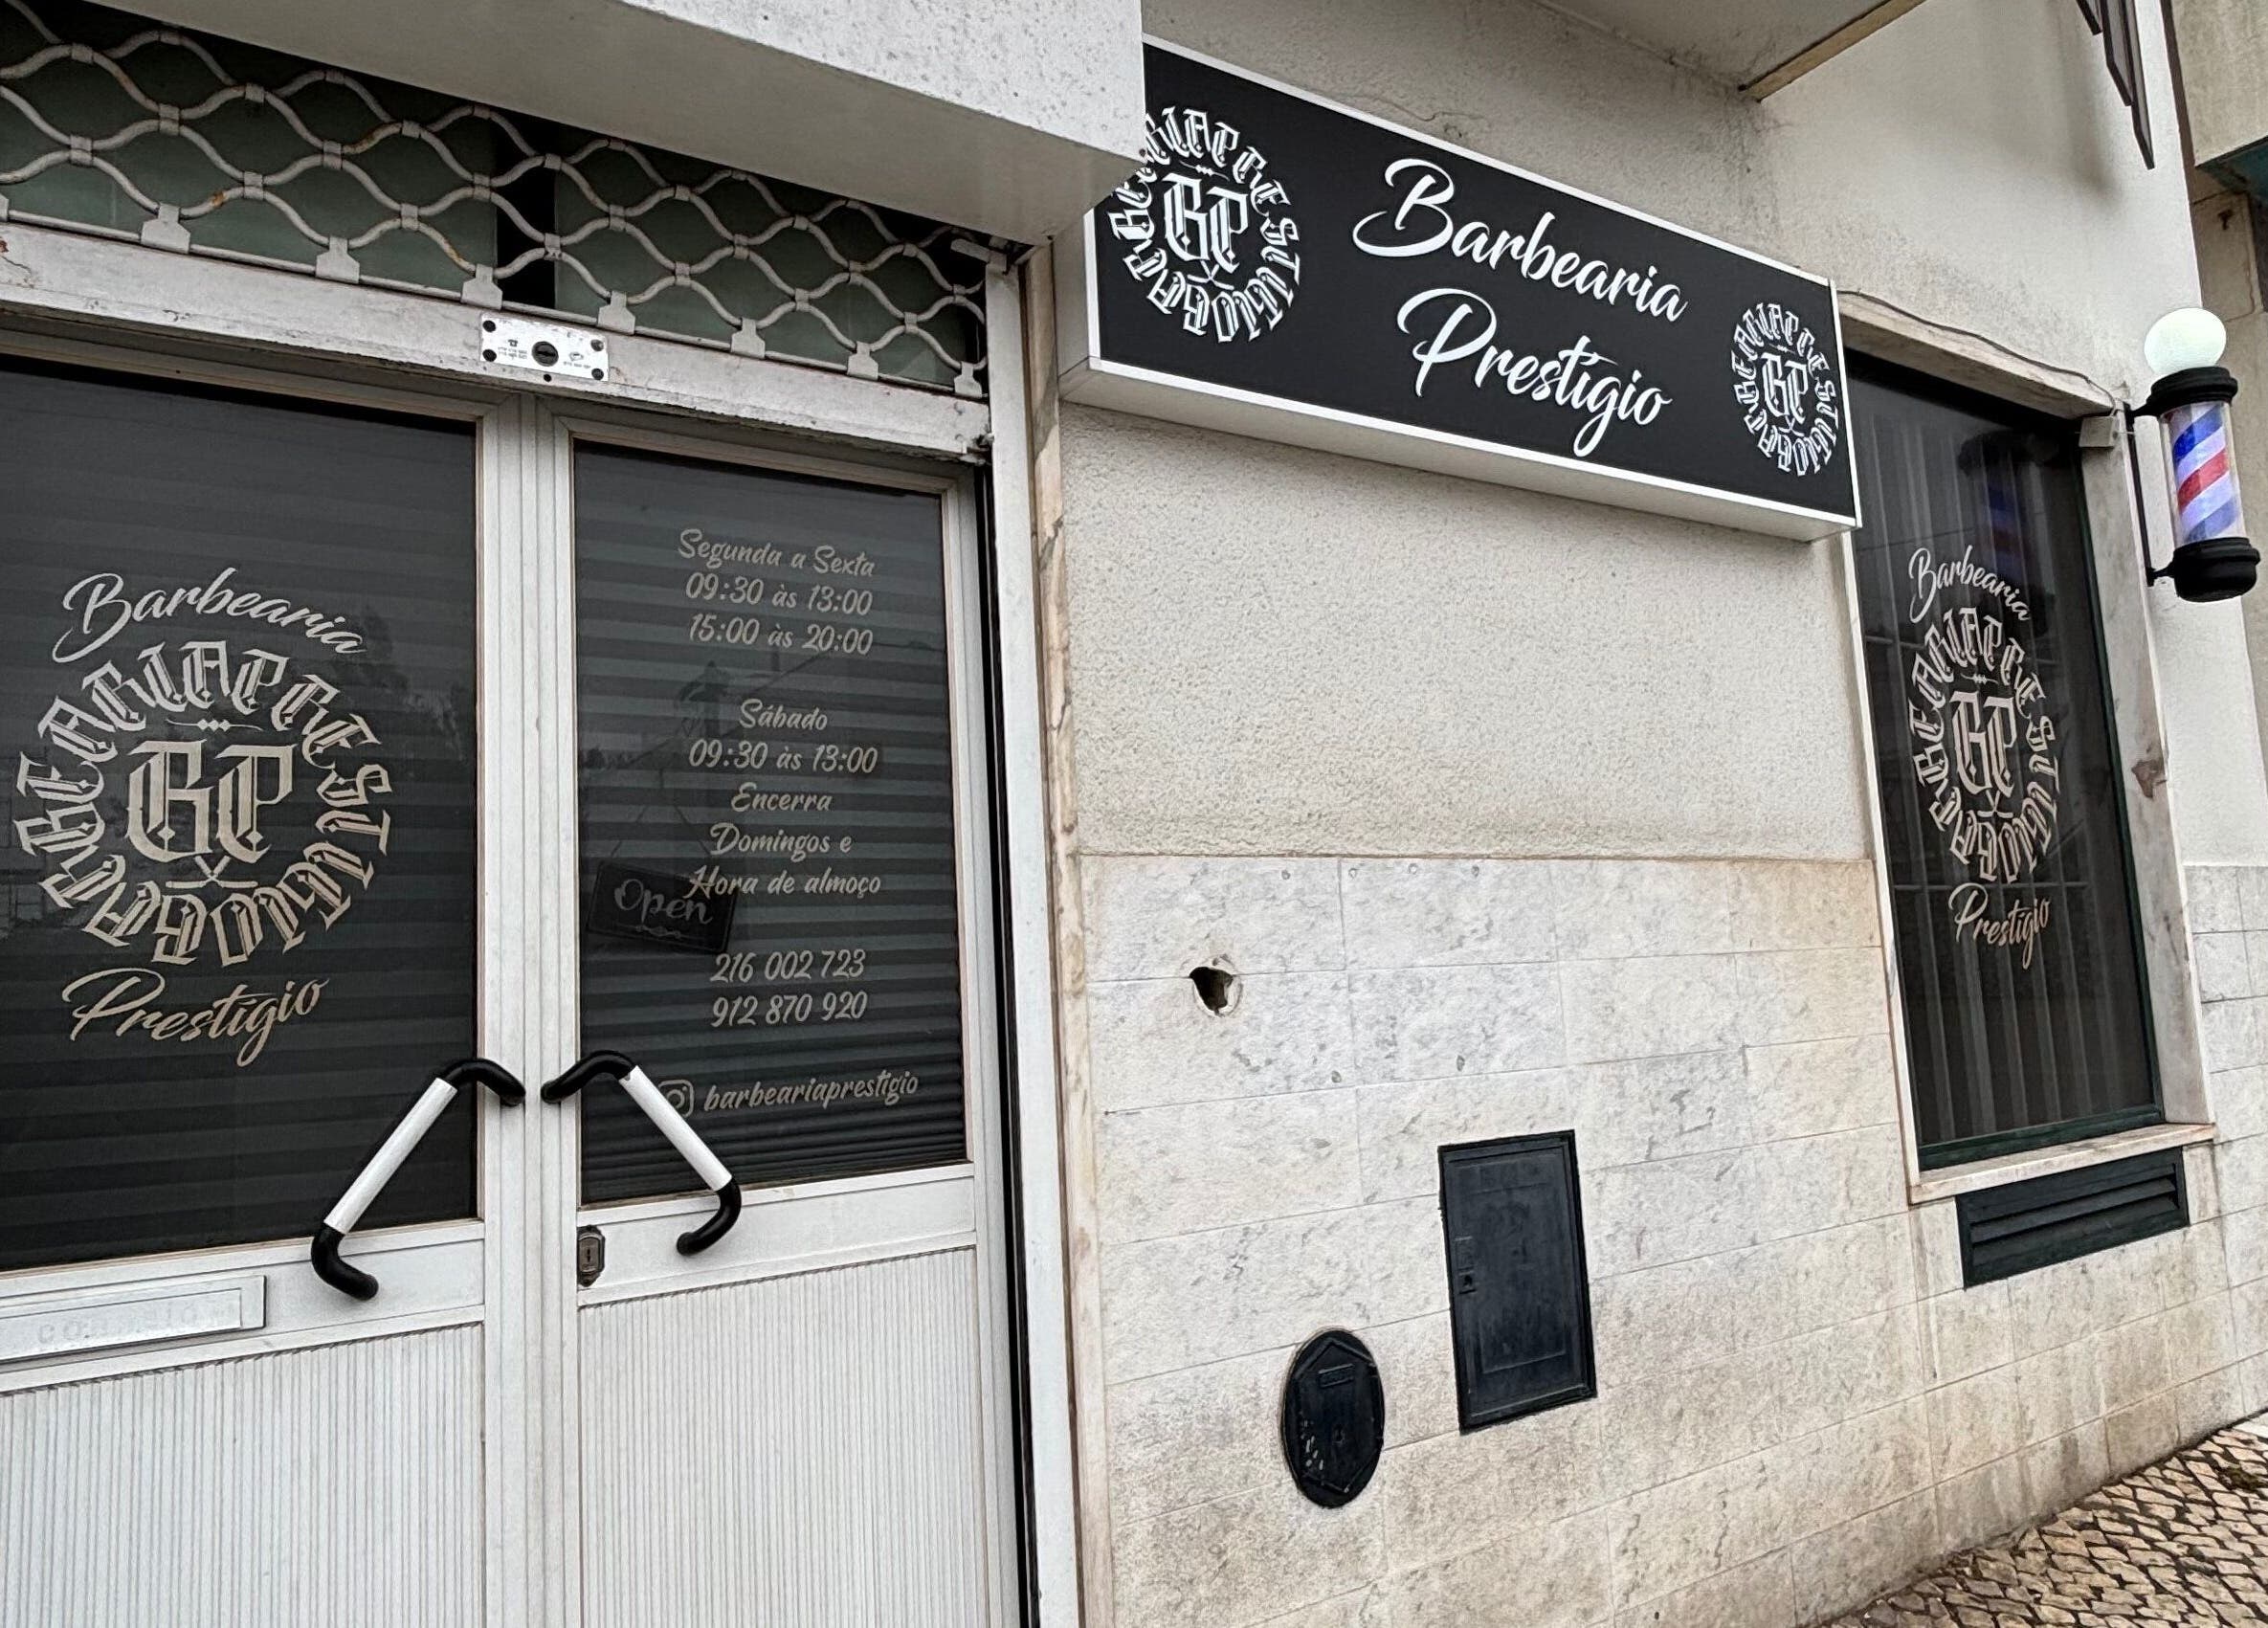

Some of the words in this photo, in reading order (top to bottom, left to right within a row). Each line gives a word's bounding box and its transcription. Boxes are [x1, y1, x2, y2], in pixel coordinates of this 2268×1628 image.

[1352, 158, 1688, 322] Barbearia
[678, 528, 781, 569] Segunda
[790, 552, 807, 569] a
[813, 545, 875, 576] Sexta
[685, 572, 764, 605] 09:30
[772, 583, 797, 608] às
[807, 586, 873, 615] 13:00
[1908, 545, 2031, 624] Barbearia
[52, 568, 368, 663] Barbearia
[689, 613, 760, 644] 15:00
[767, 623, 793, 648] às
[802, 624, 873, 654] 20:00
[739, 698, 827, 730] Sábado
[689, 739, 767, 769] 09:30
[776, 747, 802, 769] às
[812, 744, 878, 773] 13:00
[730, 782, 833, 813] Encerra
[710, 822, 830, 862] Domingos
[840, 835, 852, 853] e
[613, 879, 713, 925] Open
[683, 865, 757, 899] Hora
[767, 870, 794, 894] de
[804, 867, 880, 898] almoço
[709, 953, 756, 983] 216
[765, 949, 813, 980] 002
[820, 948, 866, 978] 723
[711, 995, 757, 1028] 912
[765, 993, 812, 1025] 870
[821, 991, 868, 1020] 920
[704, 1069, 919, 1111] barbeariaprestigio
